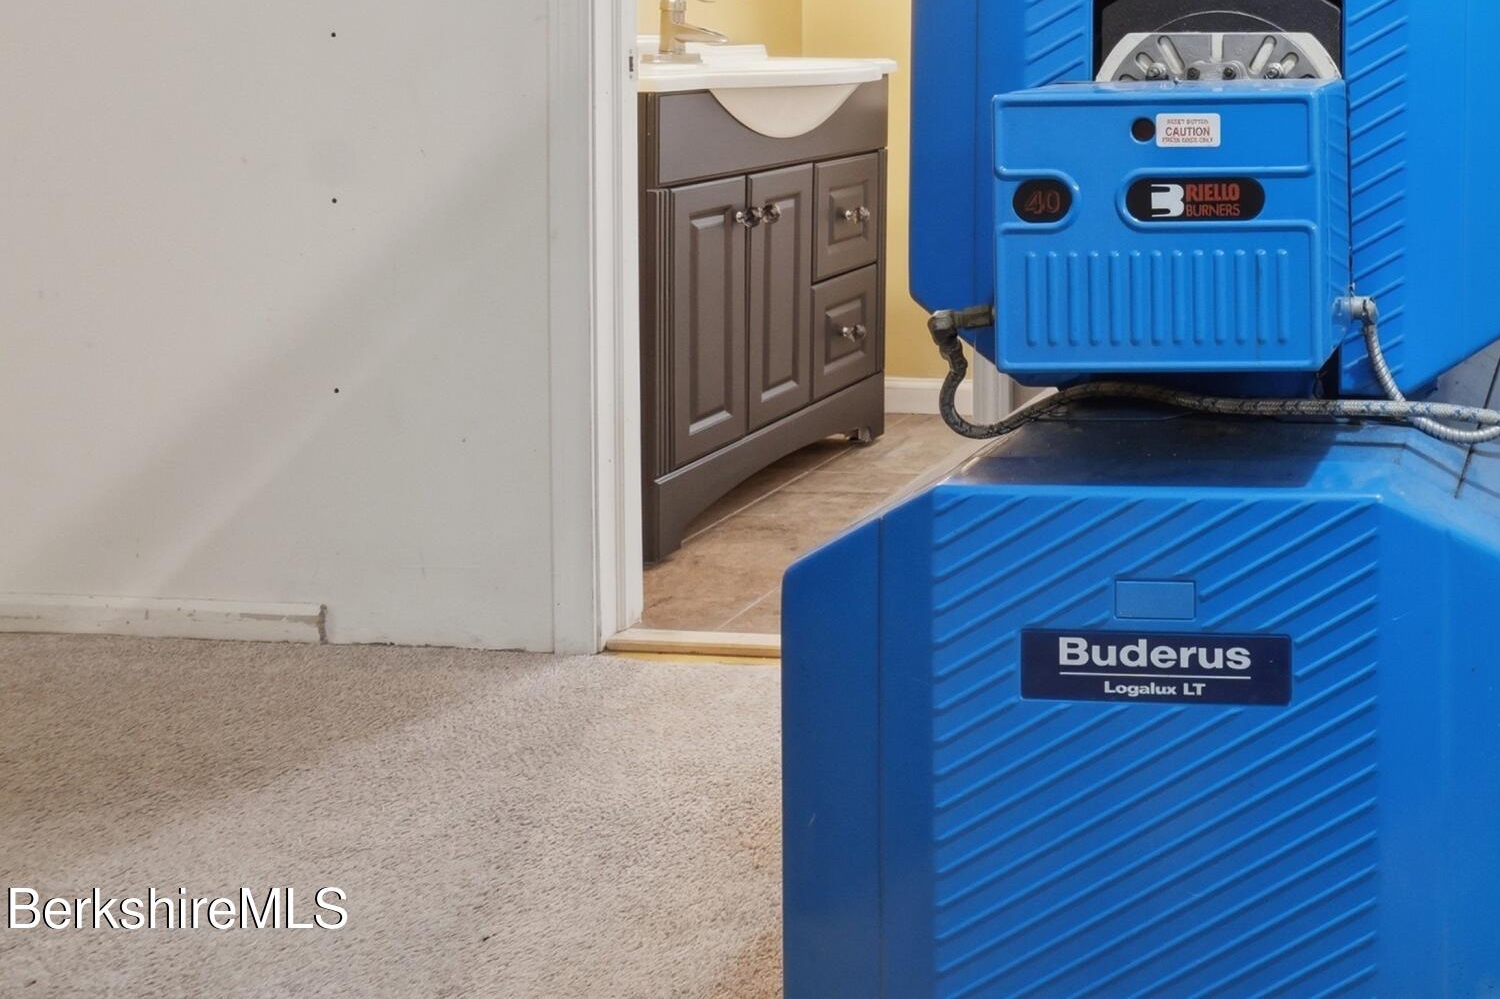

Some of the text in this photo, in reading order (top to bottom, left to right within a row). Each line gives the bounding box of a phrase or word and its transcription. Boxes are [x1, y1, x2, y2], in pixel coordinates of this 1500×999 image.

[1165, 126, 1211, 137] CAUTION
[1024, 188, 1061, 214] 40
[1185, 183, 1240, 202] RIELLO
[1185, 203, 1241, 217] BURNERS
[1058, 636, 1252, 670] Buderus
[1103, 681, 1206, 698] Logalux LT
